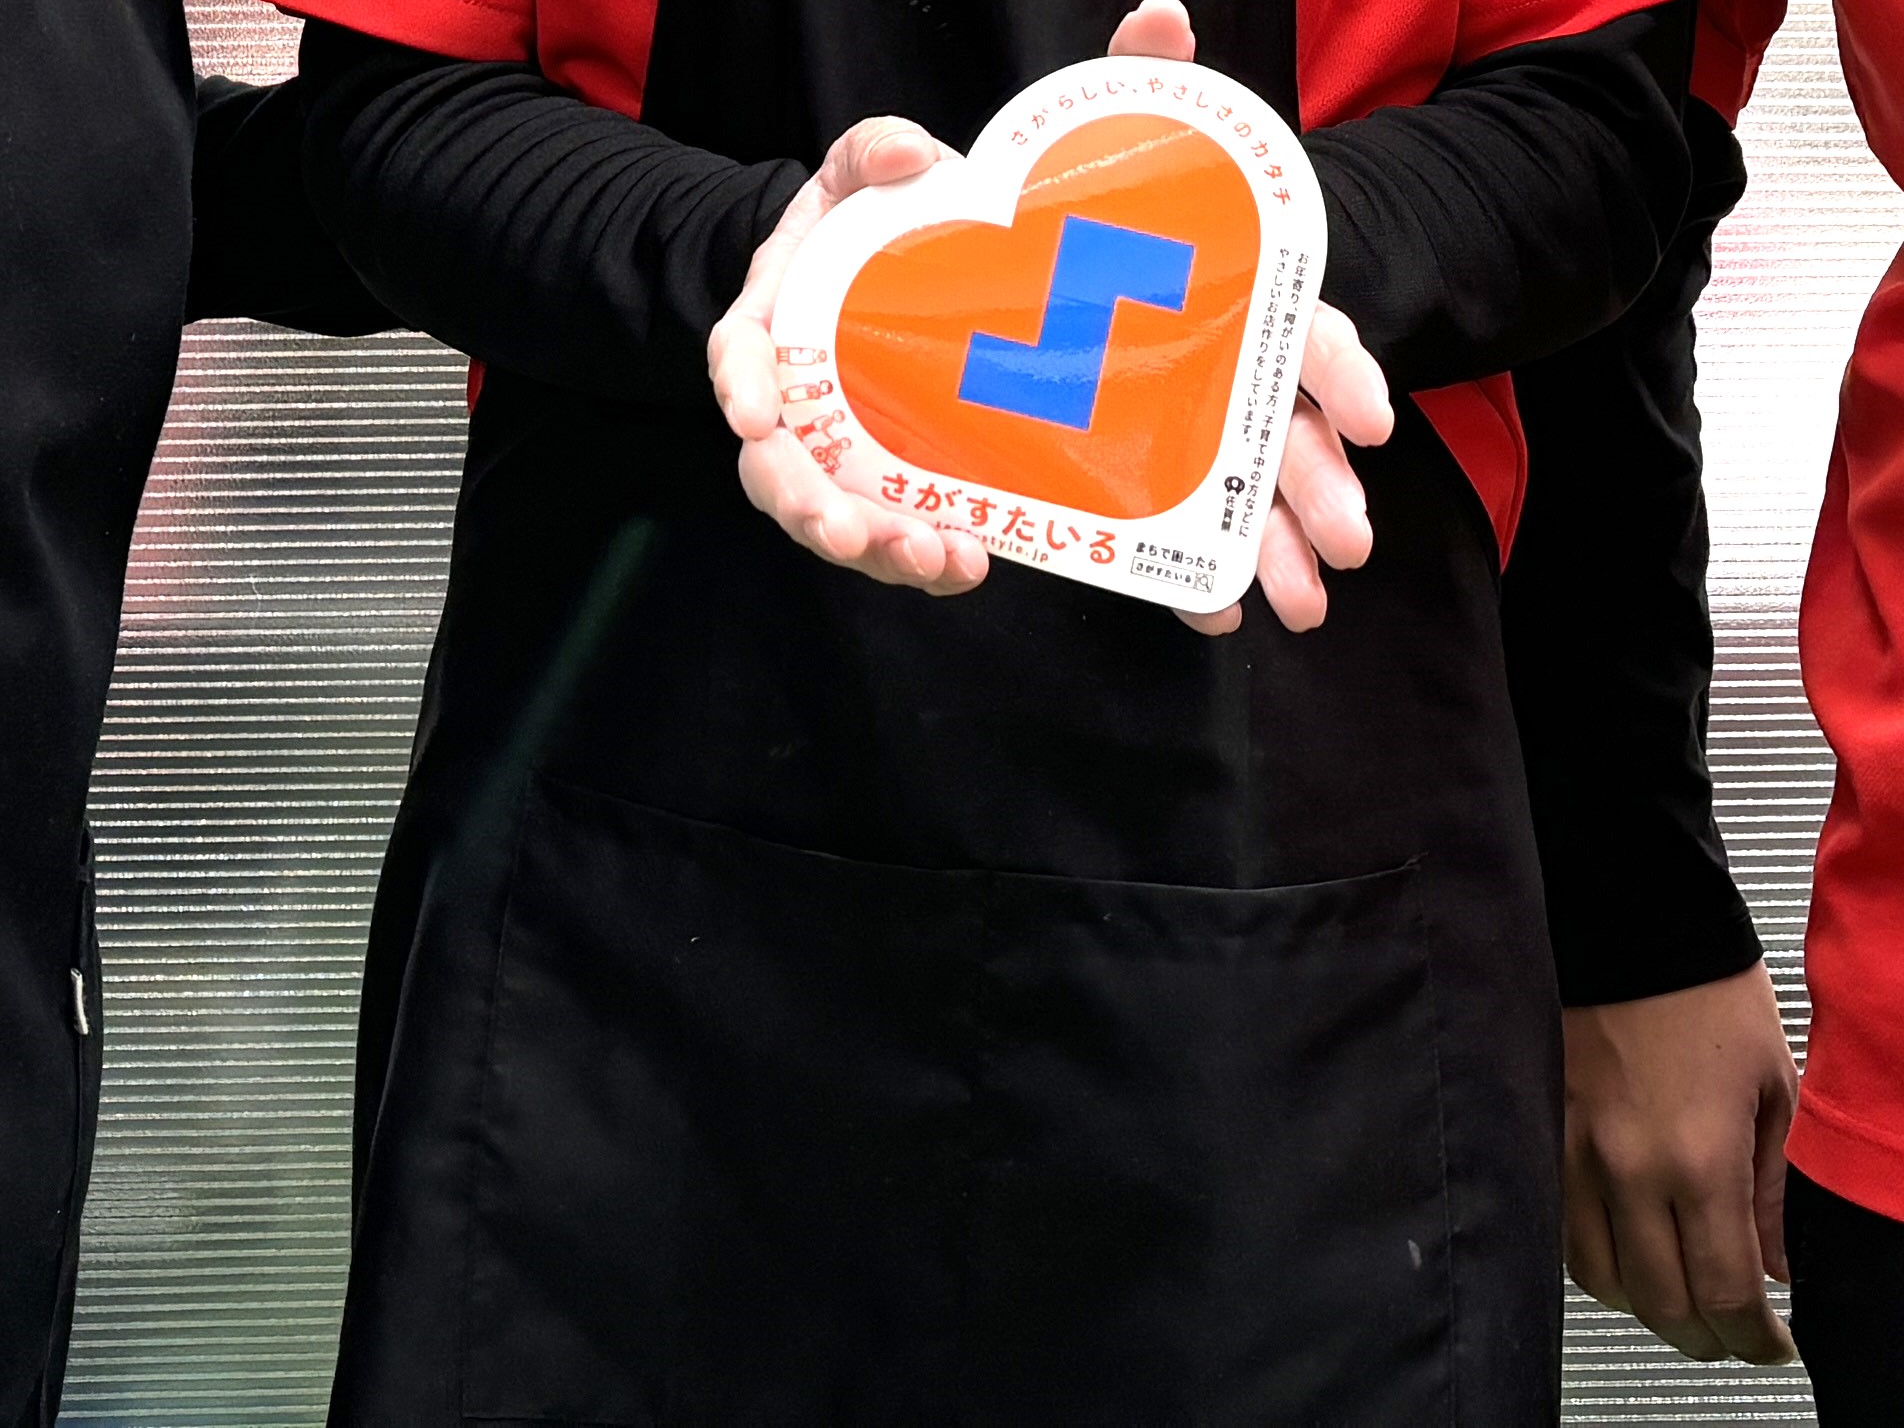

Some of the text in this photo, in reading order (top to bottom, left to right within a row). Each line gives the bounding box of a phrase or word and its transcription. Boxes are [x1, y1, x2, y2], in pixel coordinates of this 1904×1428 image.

[882, 473, 1116, 564] さがすたいる
